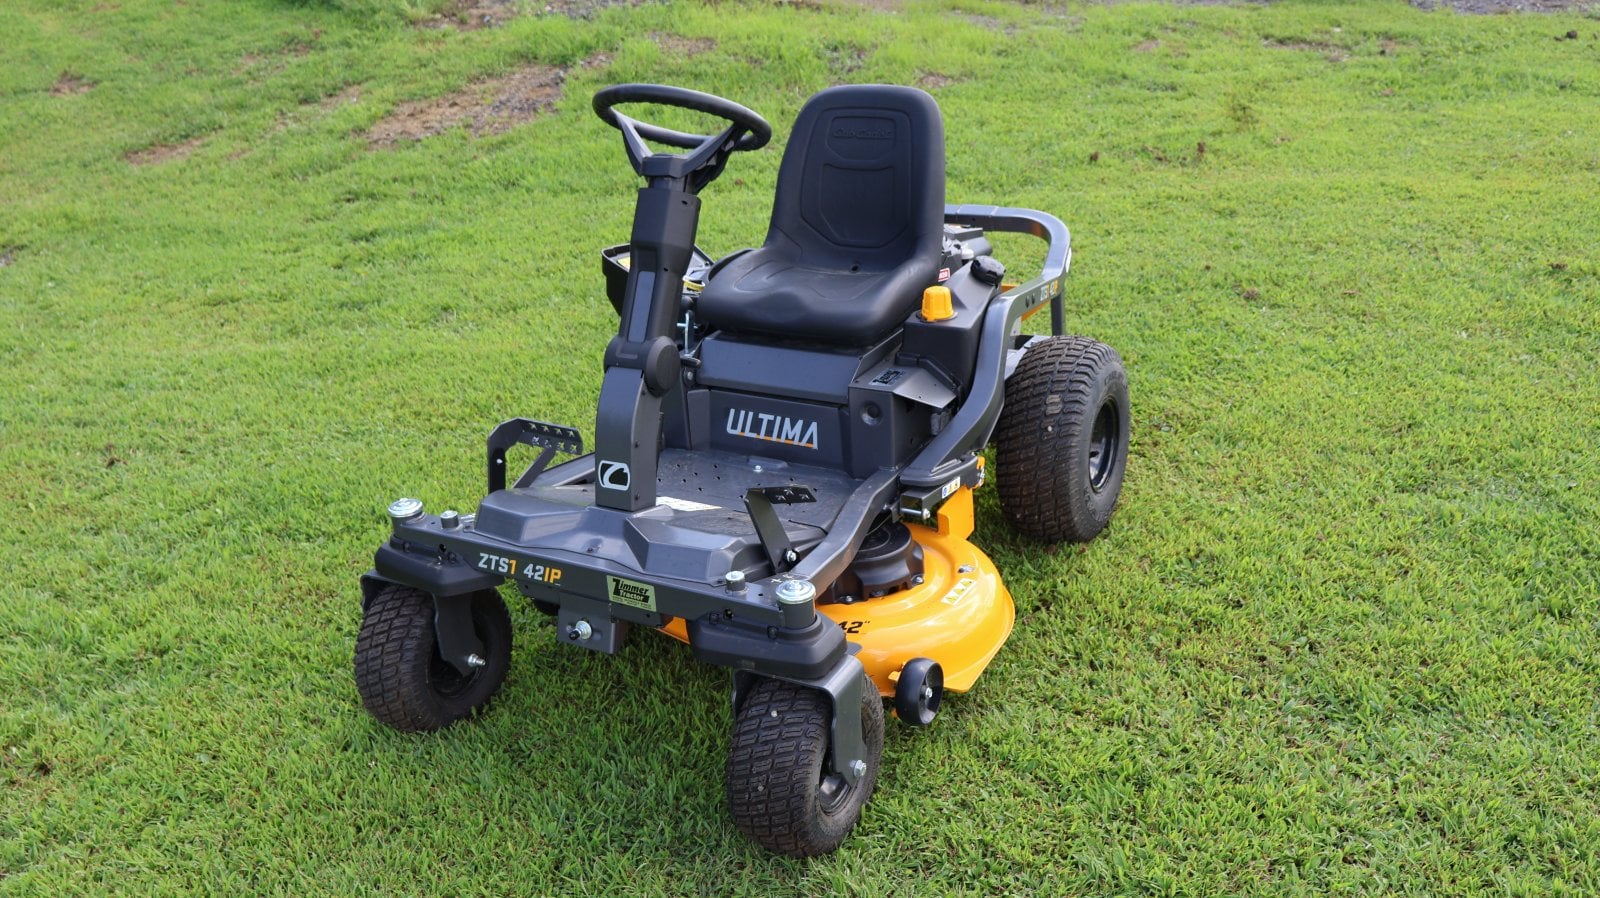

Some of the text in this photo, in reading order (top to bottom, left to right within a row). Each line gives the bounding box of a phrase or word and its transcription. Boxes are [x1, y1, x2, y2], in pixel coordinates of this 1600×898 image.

[726, 408, 818, 450] ULTIMA
[478, 552, 562, 584] ZTS1 42IP
[612, 577, 649, 597] Zimmer
[619, 590, 644, 601] Tractor
